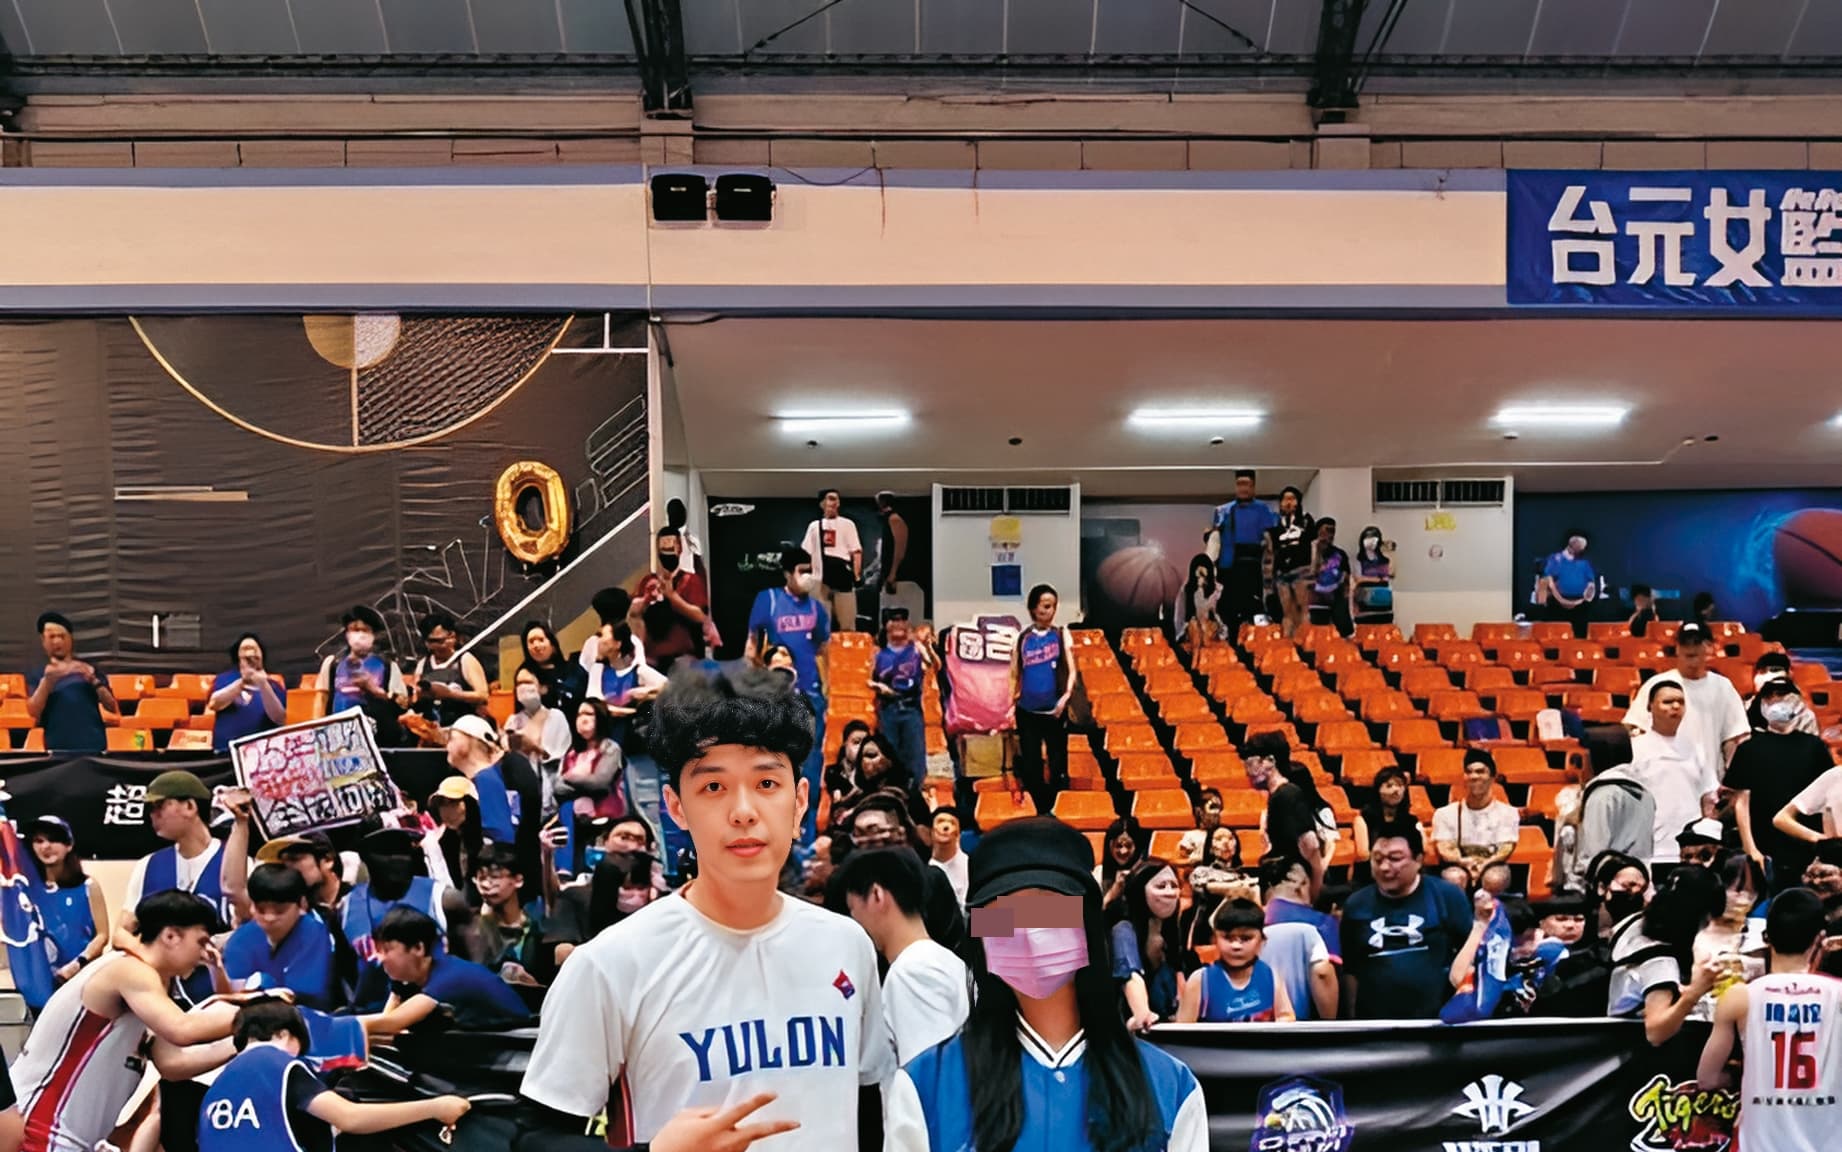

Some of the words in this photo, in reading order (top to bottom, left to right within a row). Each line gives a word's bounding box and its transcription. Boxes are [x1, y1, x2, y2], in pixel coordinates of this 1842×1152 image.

[1548, 186, 1842, 287] 台元女籃
[679, 1016, 846, 1082] YULON
[1771, 1031, 1816, 1089] 16
